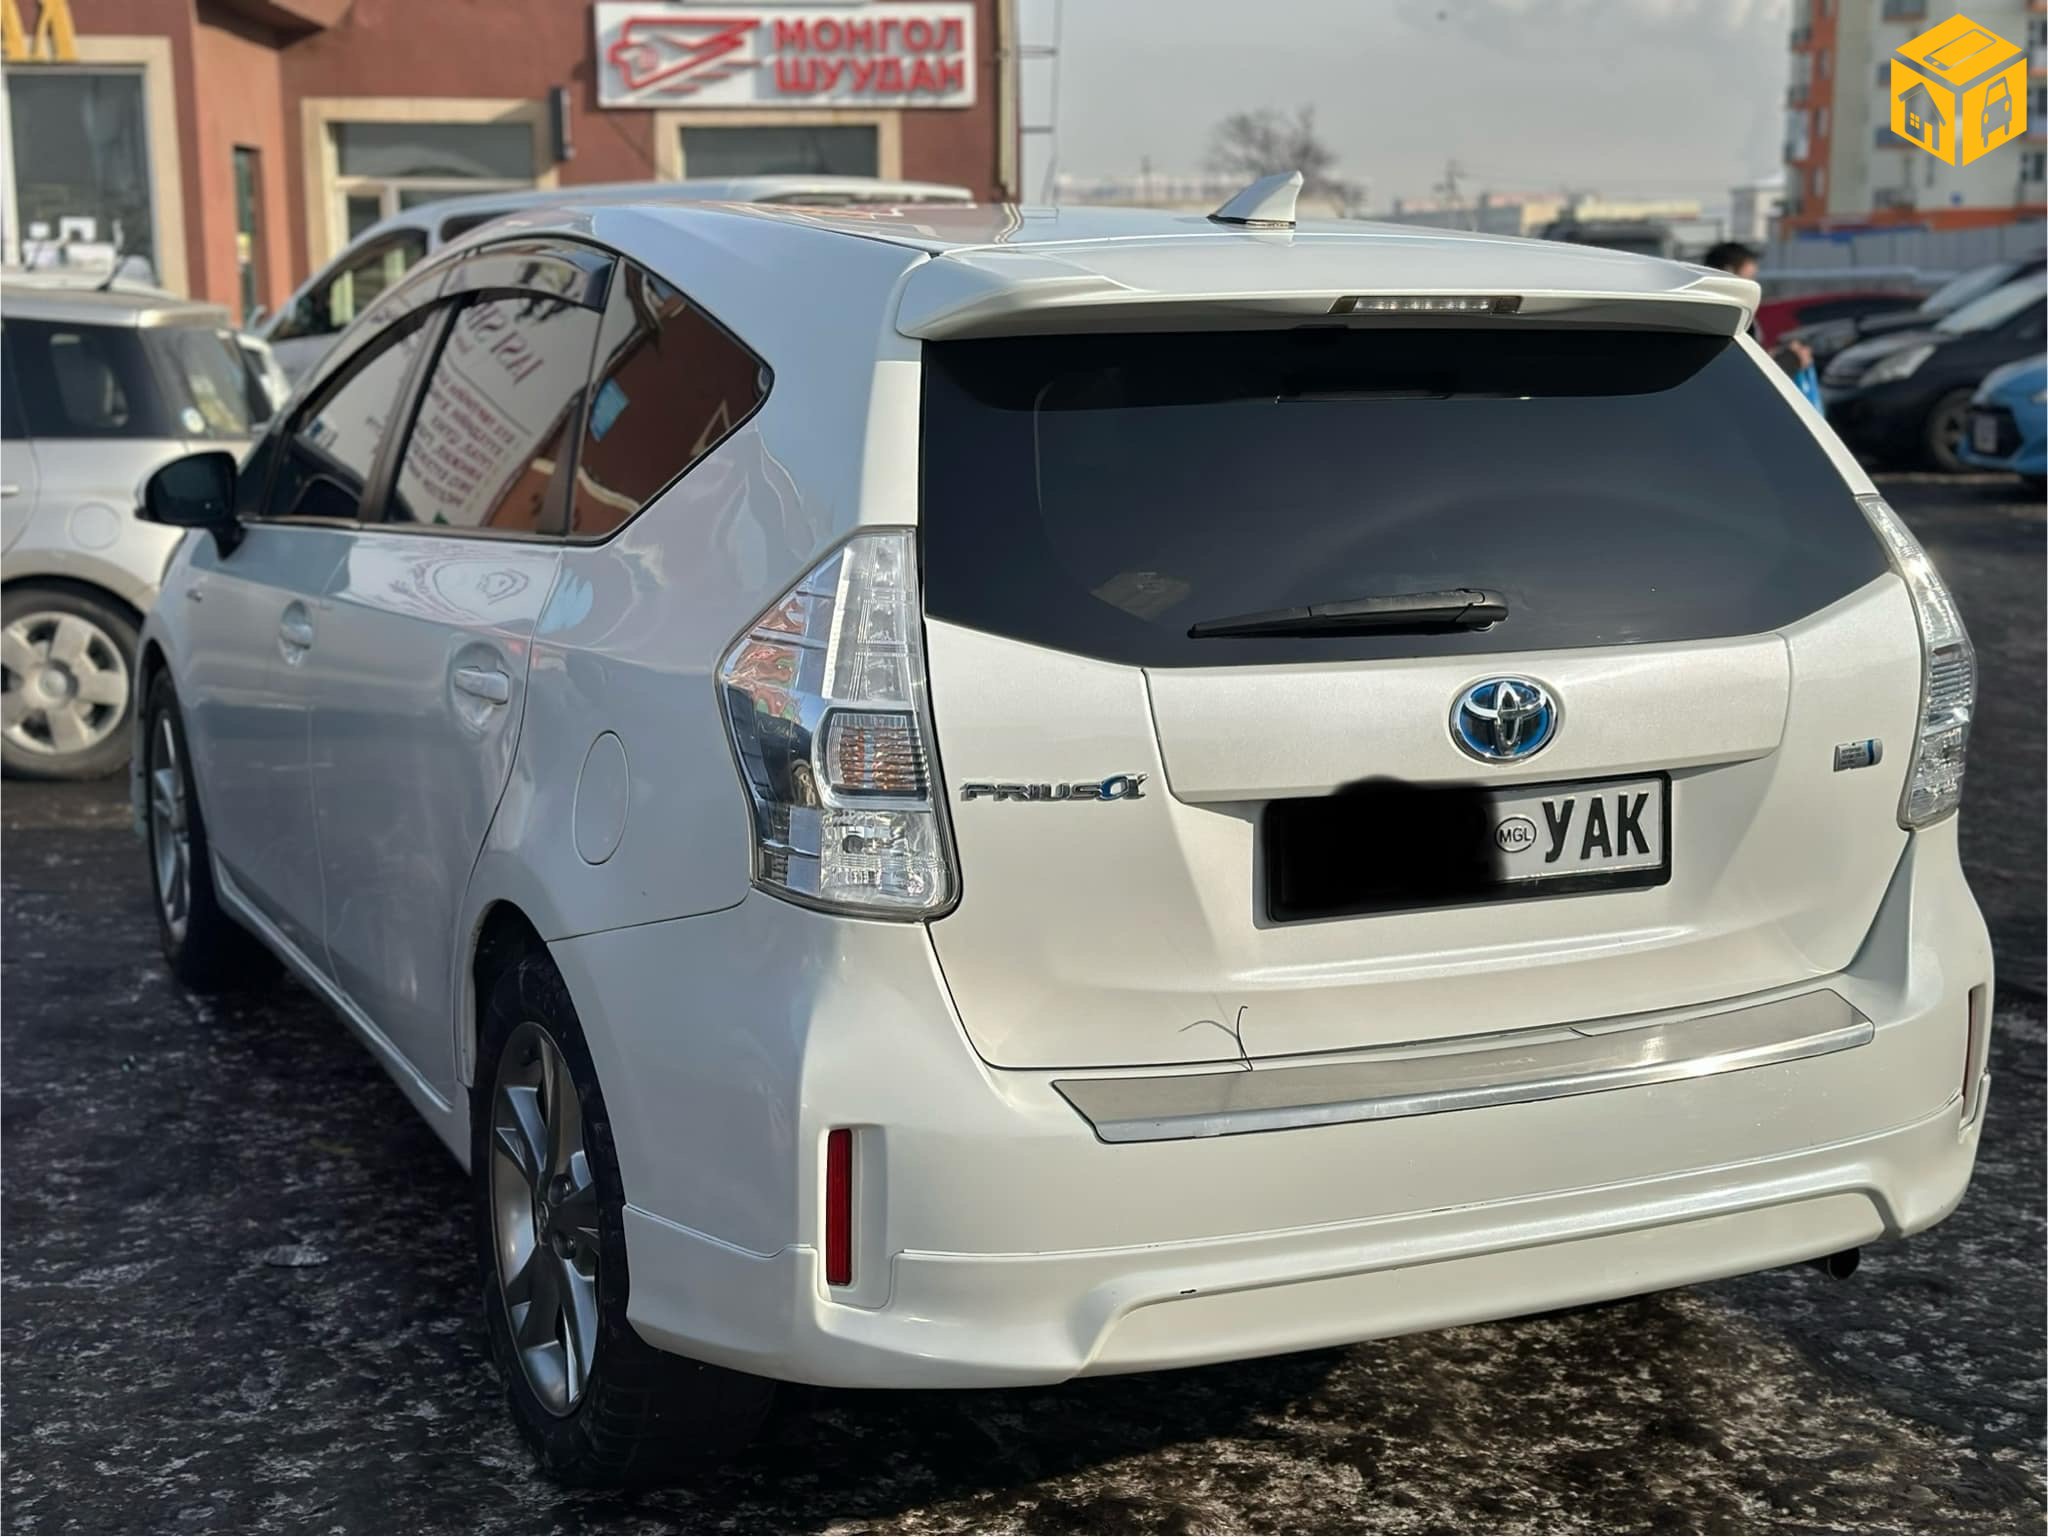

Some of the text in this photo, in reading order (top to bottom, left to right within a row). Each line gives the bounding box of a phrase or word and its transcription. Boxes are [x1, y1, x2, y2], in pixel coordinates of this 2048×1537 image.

[774, 19, 964, 53] МОНГОЛ
[774, 57, 964, 92] ШУУДАН
[1499, 826, 1532, 844] MGL
